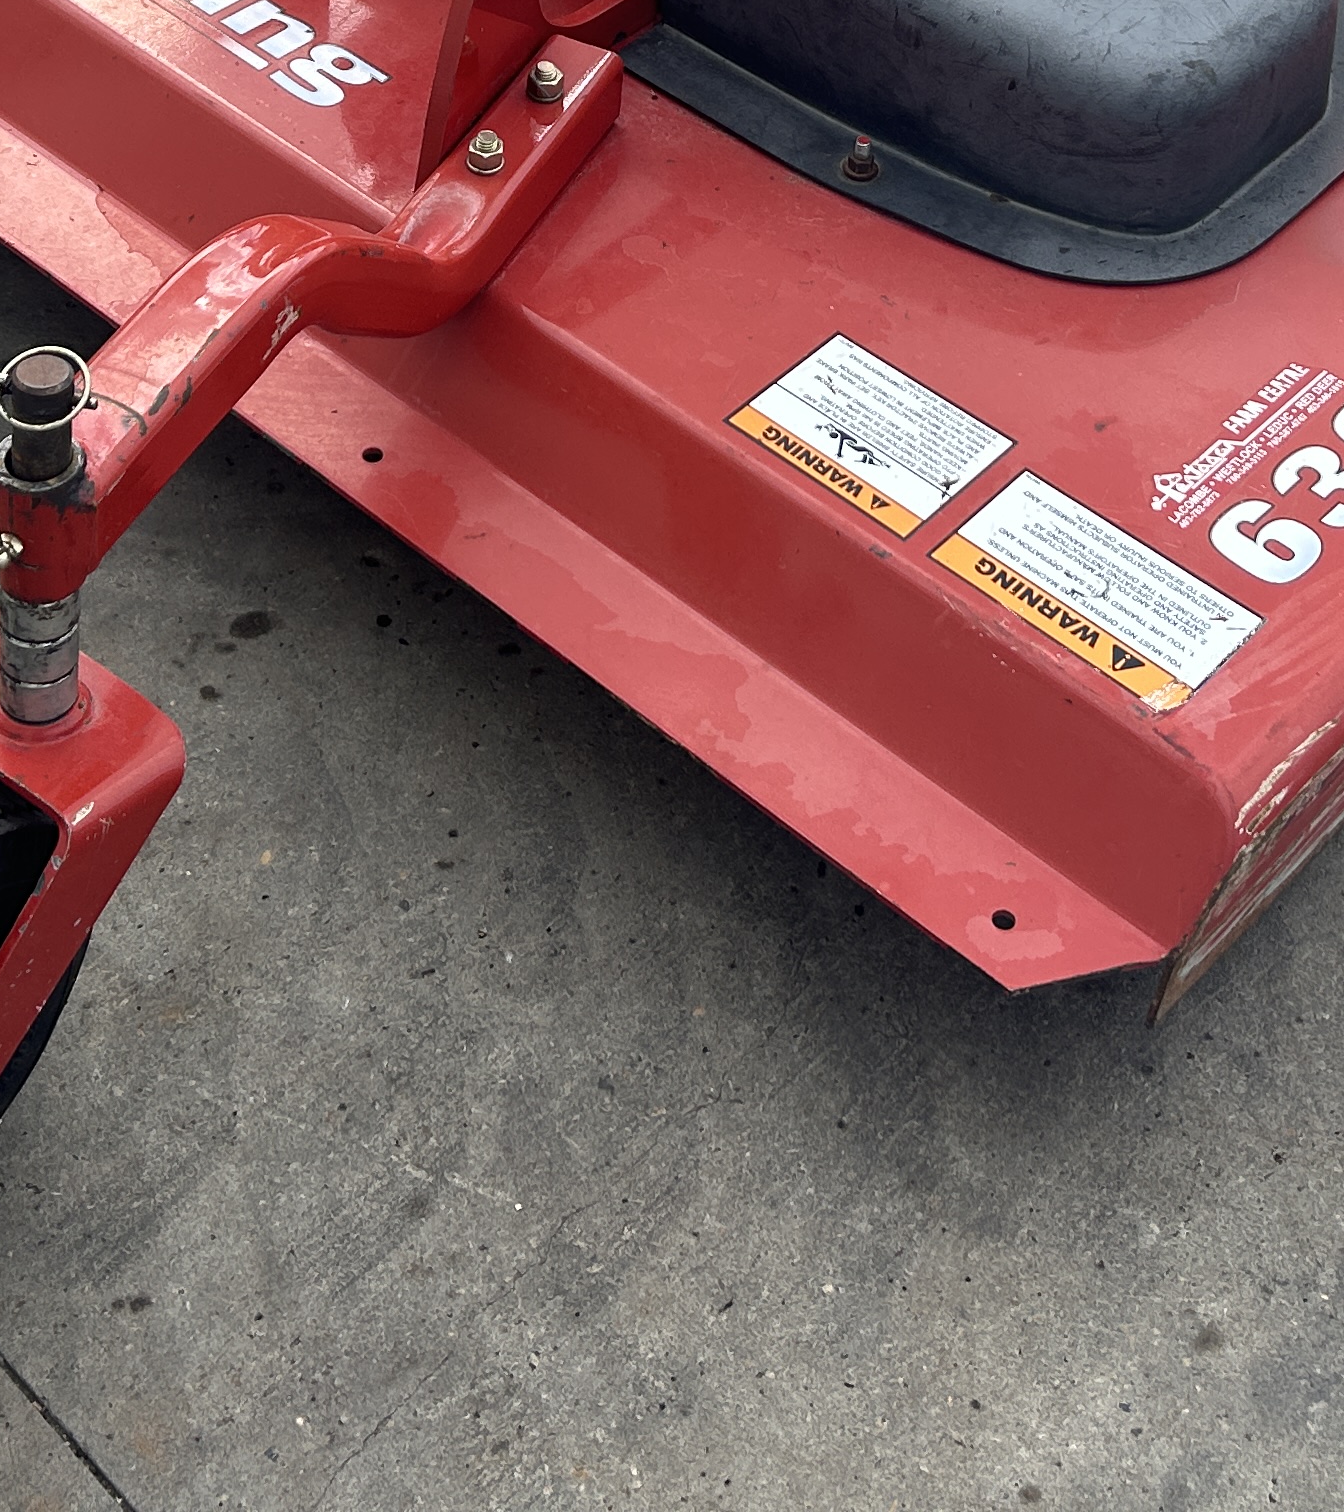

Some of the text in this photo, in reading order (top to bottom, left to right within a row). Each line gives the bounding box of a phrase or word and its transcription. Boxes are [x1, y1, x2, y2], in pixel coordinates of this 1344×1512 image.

[1222, 398, 1269, 435] FARM
[1257, 361, 1311, 402] CENTRE
[1168, 372, 1337, 523] LACOMBE WESTLOCK LEDUC RED DEER
[762, 425, 863, 497] WARNING
[1023, 491, 1042, 503] AND
[1041, 504, 1077, 526] HIMSELF
[999, 528, 1016, 540] AND
[1077, 525, 1120, 553] SUBJECTS
[1017, 539, 1063, 570] OPERATION
[1046, 531, 1105, 570] INSTRUCTIONS
[1117, 543, 1148, 562] INJURY
[1021, 561, 1059, 588] MACHINE
[1120, 552, 1165, 582] OPERATOR
[1148, 561, 1185, 586] SERIOUS
[1094, 572, 1131, 596] FOLLOW
[1106, 569, 1153, 600] OPERATING
[1140, 582, 1156, 595] THE
[975, 557, 1100, 648] WARNING
[1132, 595, 1150, 608] AND
[1154, 601, 1173, 613] AND
[1166, 582, 1215, 614] UNTRAINED
[1199, 594, 1234, 617] OTHERS
[1080, 599, 1118, 626] OPERATE
[1111, 601, 1147, 627] TRAINED
[1151, 608, 1178, 626] KNOW
[1168, 601, 1211, 629] OUTLINED
[1118, 626, 1138, 639] NOT
[1148, 625, 1167, 638] ARE
[1173, 614, 1206, 635] SAFETY
[1178, 625, 1196, 640] YOU
[1137, 639, 1163, 656] MUST
[1167, 637, 1185, 652] YOU
[1163, 655, 1181, 669] YOU
